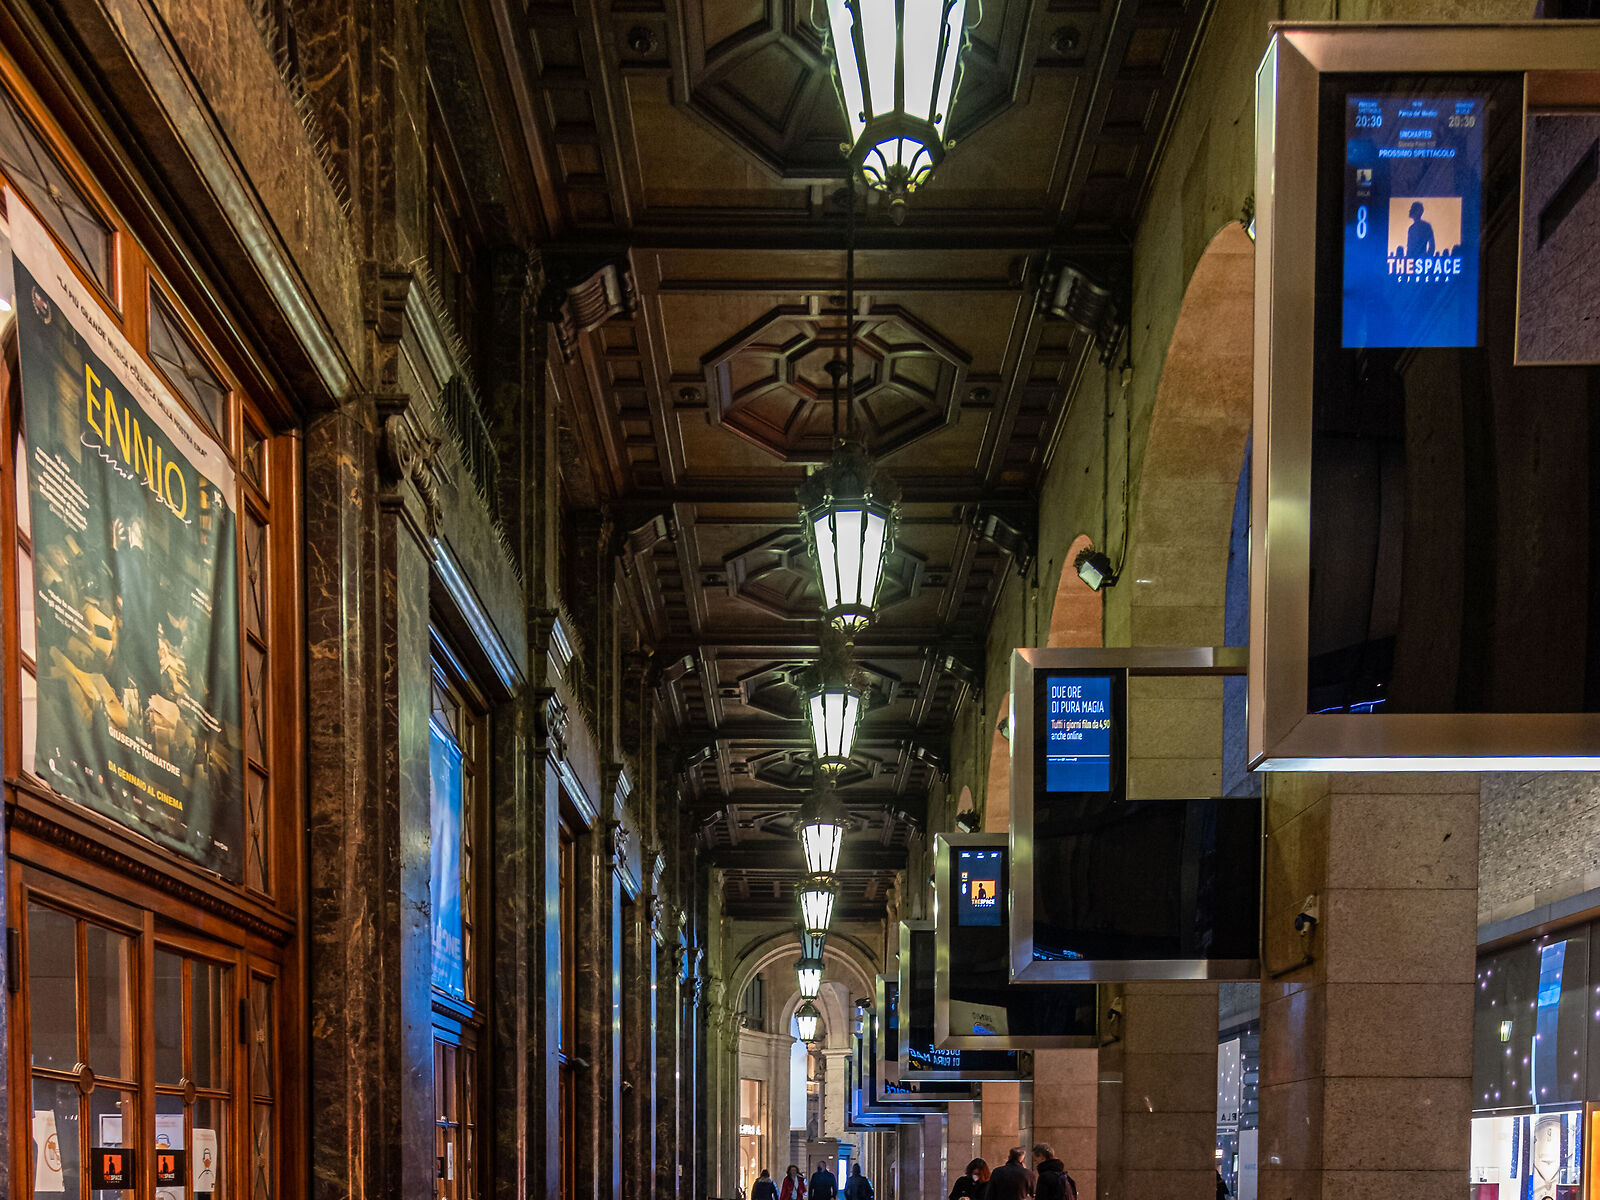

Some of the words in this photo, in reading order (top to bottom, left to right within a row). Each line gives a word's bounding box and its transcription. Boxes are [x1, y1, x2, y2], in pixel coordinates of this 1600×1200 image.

[1355, 115, 1383, 128] 20:30
[1448, 115, 1476, 128] 20:30
[1378, 148, 1412, 158] PROSSIMO
[1413, 148, 1456, 158] SPETTACOLO
[1357, 206, 1367, 239] 8
[80, 305, 107, 342] GRANDE
[85, 363, 187, 519] ENNIO
[1051, 686, 1066, 698] DUE
[1067, 686, 1082, 698] ORE
[1051, 701, 1059, 713] DI
[1060, 701, 1080, 713] PURA
[1081, 701, 1105, 713] MAGIA
[1051, 719, 1063, 729] Tutti
[1066, 719, 1082, 731] giorni
[1082, 719, 1092, 729] film
[1092, 719, 1099, 729] da
[1051, 731, 1066, 741] anche
[1067, 731, 1083, 740] online
[108, 726, 141, 754] GIUSEPPE
[141, 747, 181, 777] TORNATORE
[108, 760, 117, 774] DA
[117, 766, 147, 791] GENNAIO
[147, 785, 156, 798] AL
[156, 790, 183, 811] CINEMA
